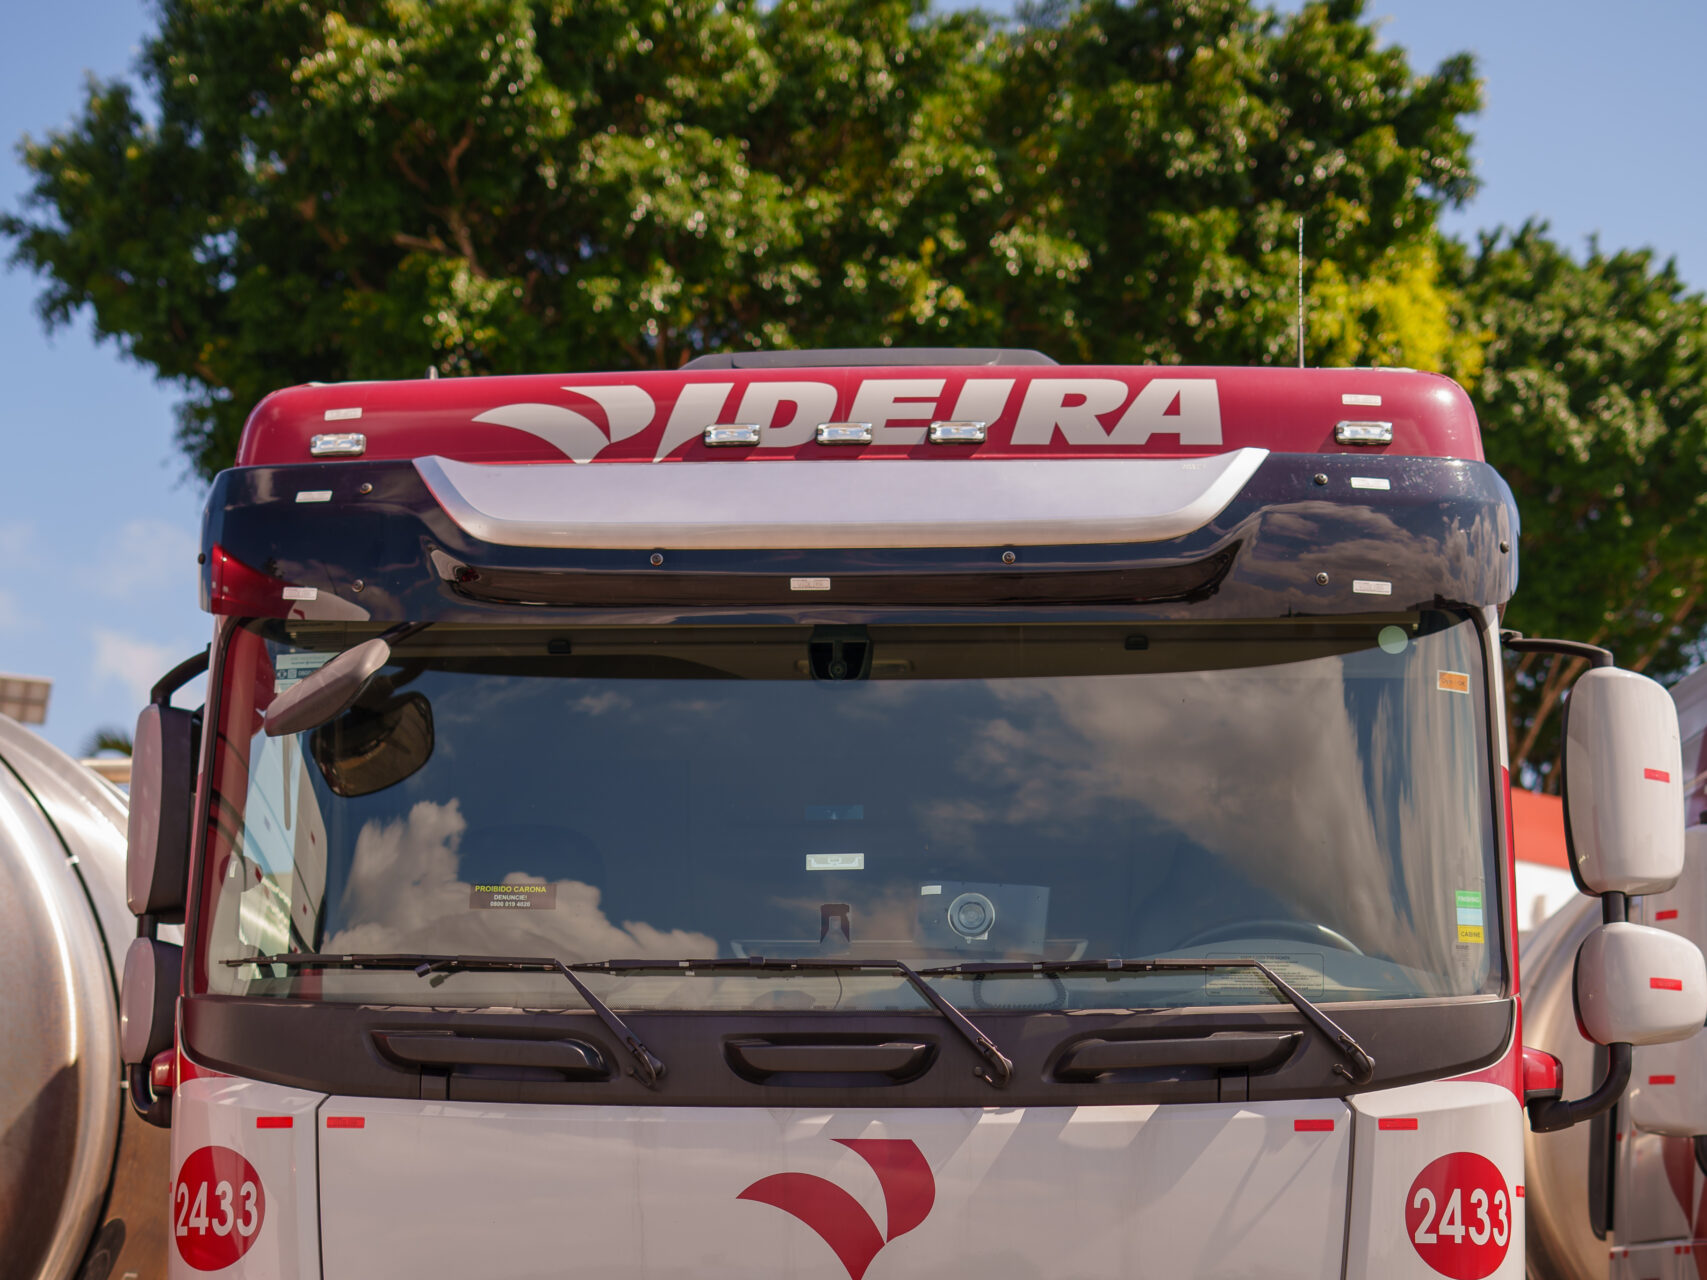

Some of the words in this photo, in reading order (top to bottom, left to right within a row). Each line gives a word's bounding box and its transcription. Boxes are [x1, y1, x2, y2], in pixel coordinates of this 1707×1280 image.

[475, 885, 512, 893] PROIBIDO
[176, 1180, 258, 1237] 2433
[1413, 1187, 1508, 1247] 2433
